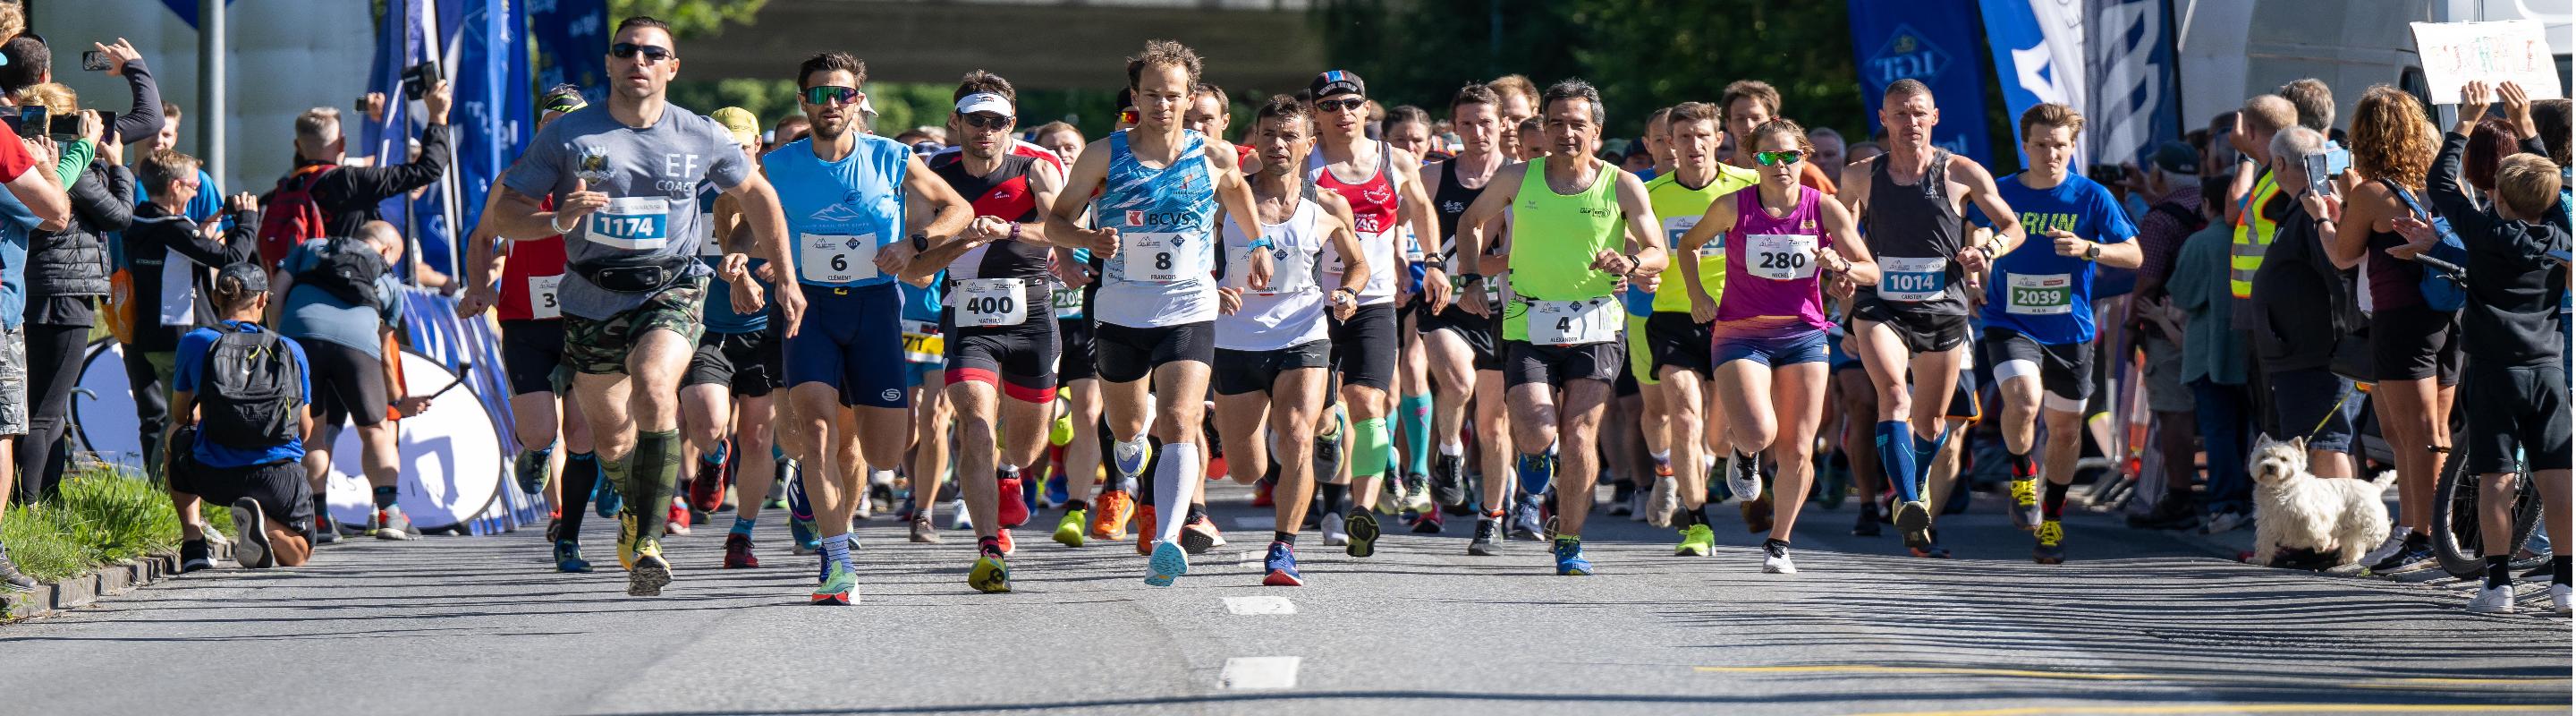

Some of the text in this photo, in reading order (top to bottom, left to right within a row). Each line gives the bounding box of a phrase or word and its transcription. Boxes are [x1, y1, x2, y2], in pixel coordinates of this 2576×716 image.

[665, 153, 699, 178] EF
[600, 217, 654, 236] 1174
[1148, 212, 1191, 226] BCVS
[2015, 211, 2078, 235] RUN
[830, 253, 848, 272] 6
[1155, 251, 1172, 270] 8
[1759, 251, 1806, 268] 280
[1890, 274, 1935, 291] 1014
[966, 296, 1014, 315] 400
[2017, 290, 2061, 304] 2039
[1555, 316, 1572, 334] 4
